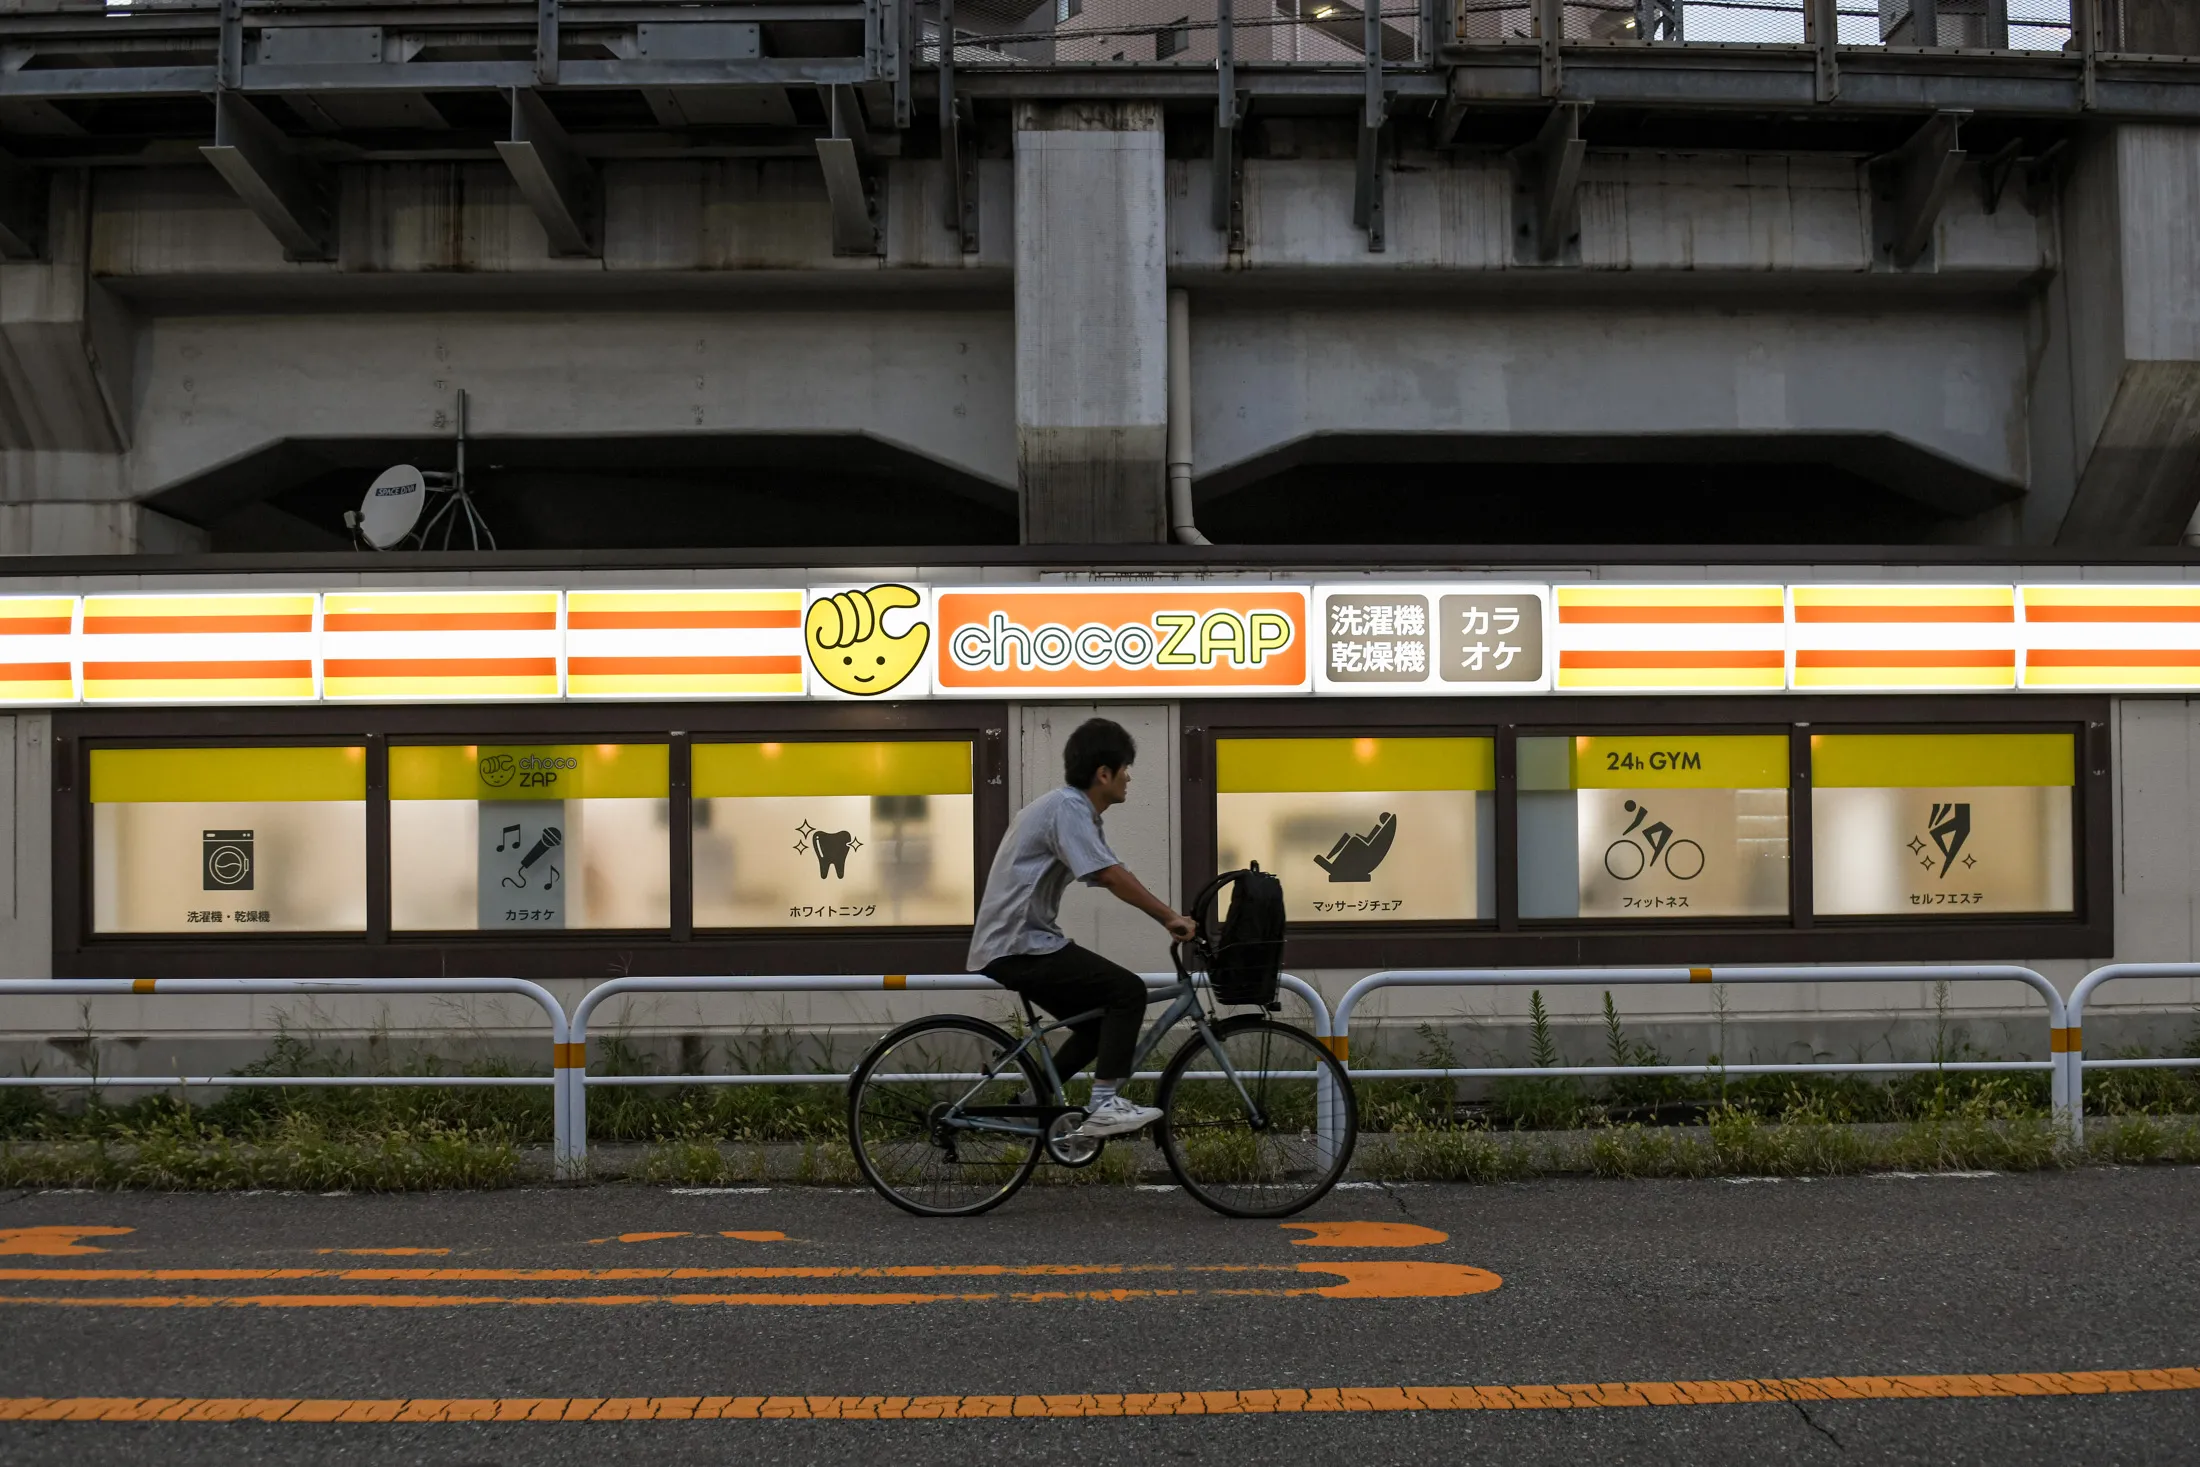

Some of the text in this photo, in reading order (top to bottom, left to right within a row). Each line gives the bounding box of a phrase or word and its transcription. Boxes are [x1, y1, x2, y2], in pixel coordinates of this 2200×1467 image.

[1331, 605, 1425, 635] 洗濯機
[1461, 606, 1520, 635] カラ
[952, 611, 1293, 667] chocoZAP
[1331, 641, 1425, 672] 乾燥機
[1461, 641, 1522, 671] オケ
[519, 755, 577, 770] choco
[1606, 751, 1702, 770] 24h GYM
[519, 772, 557, 787] ZAP
[1312, 900, 1403, 912] マッサージチェア
[1622, 896, 1689, 908] フィットネス
[1909, 893, 1983, 905] セルフエステ
[187, 910, 271, 923] 洗濯機・乾燥機
[505, 909, 555, 921] カラオケ
[789, 905, 876, 918] ホワイトニング
